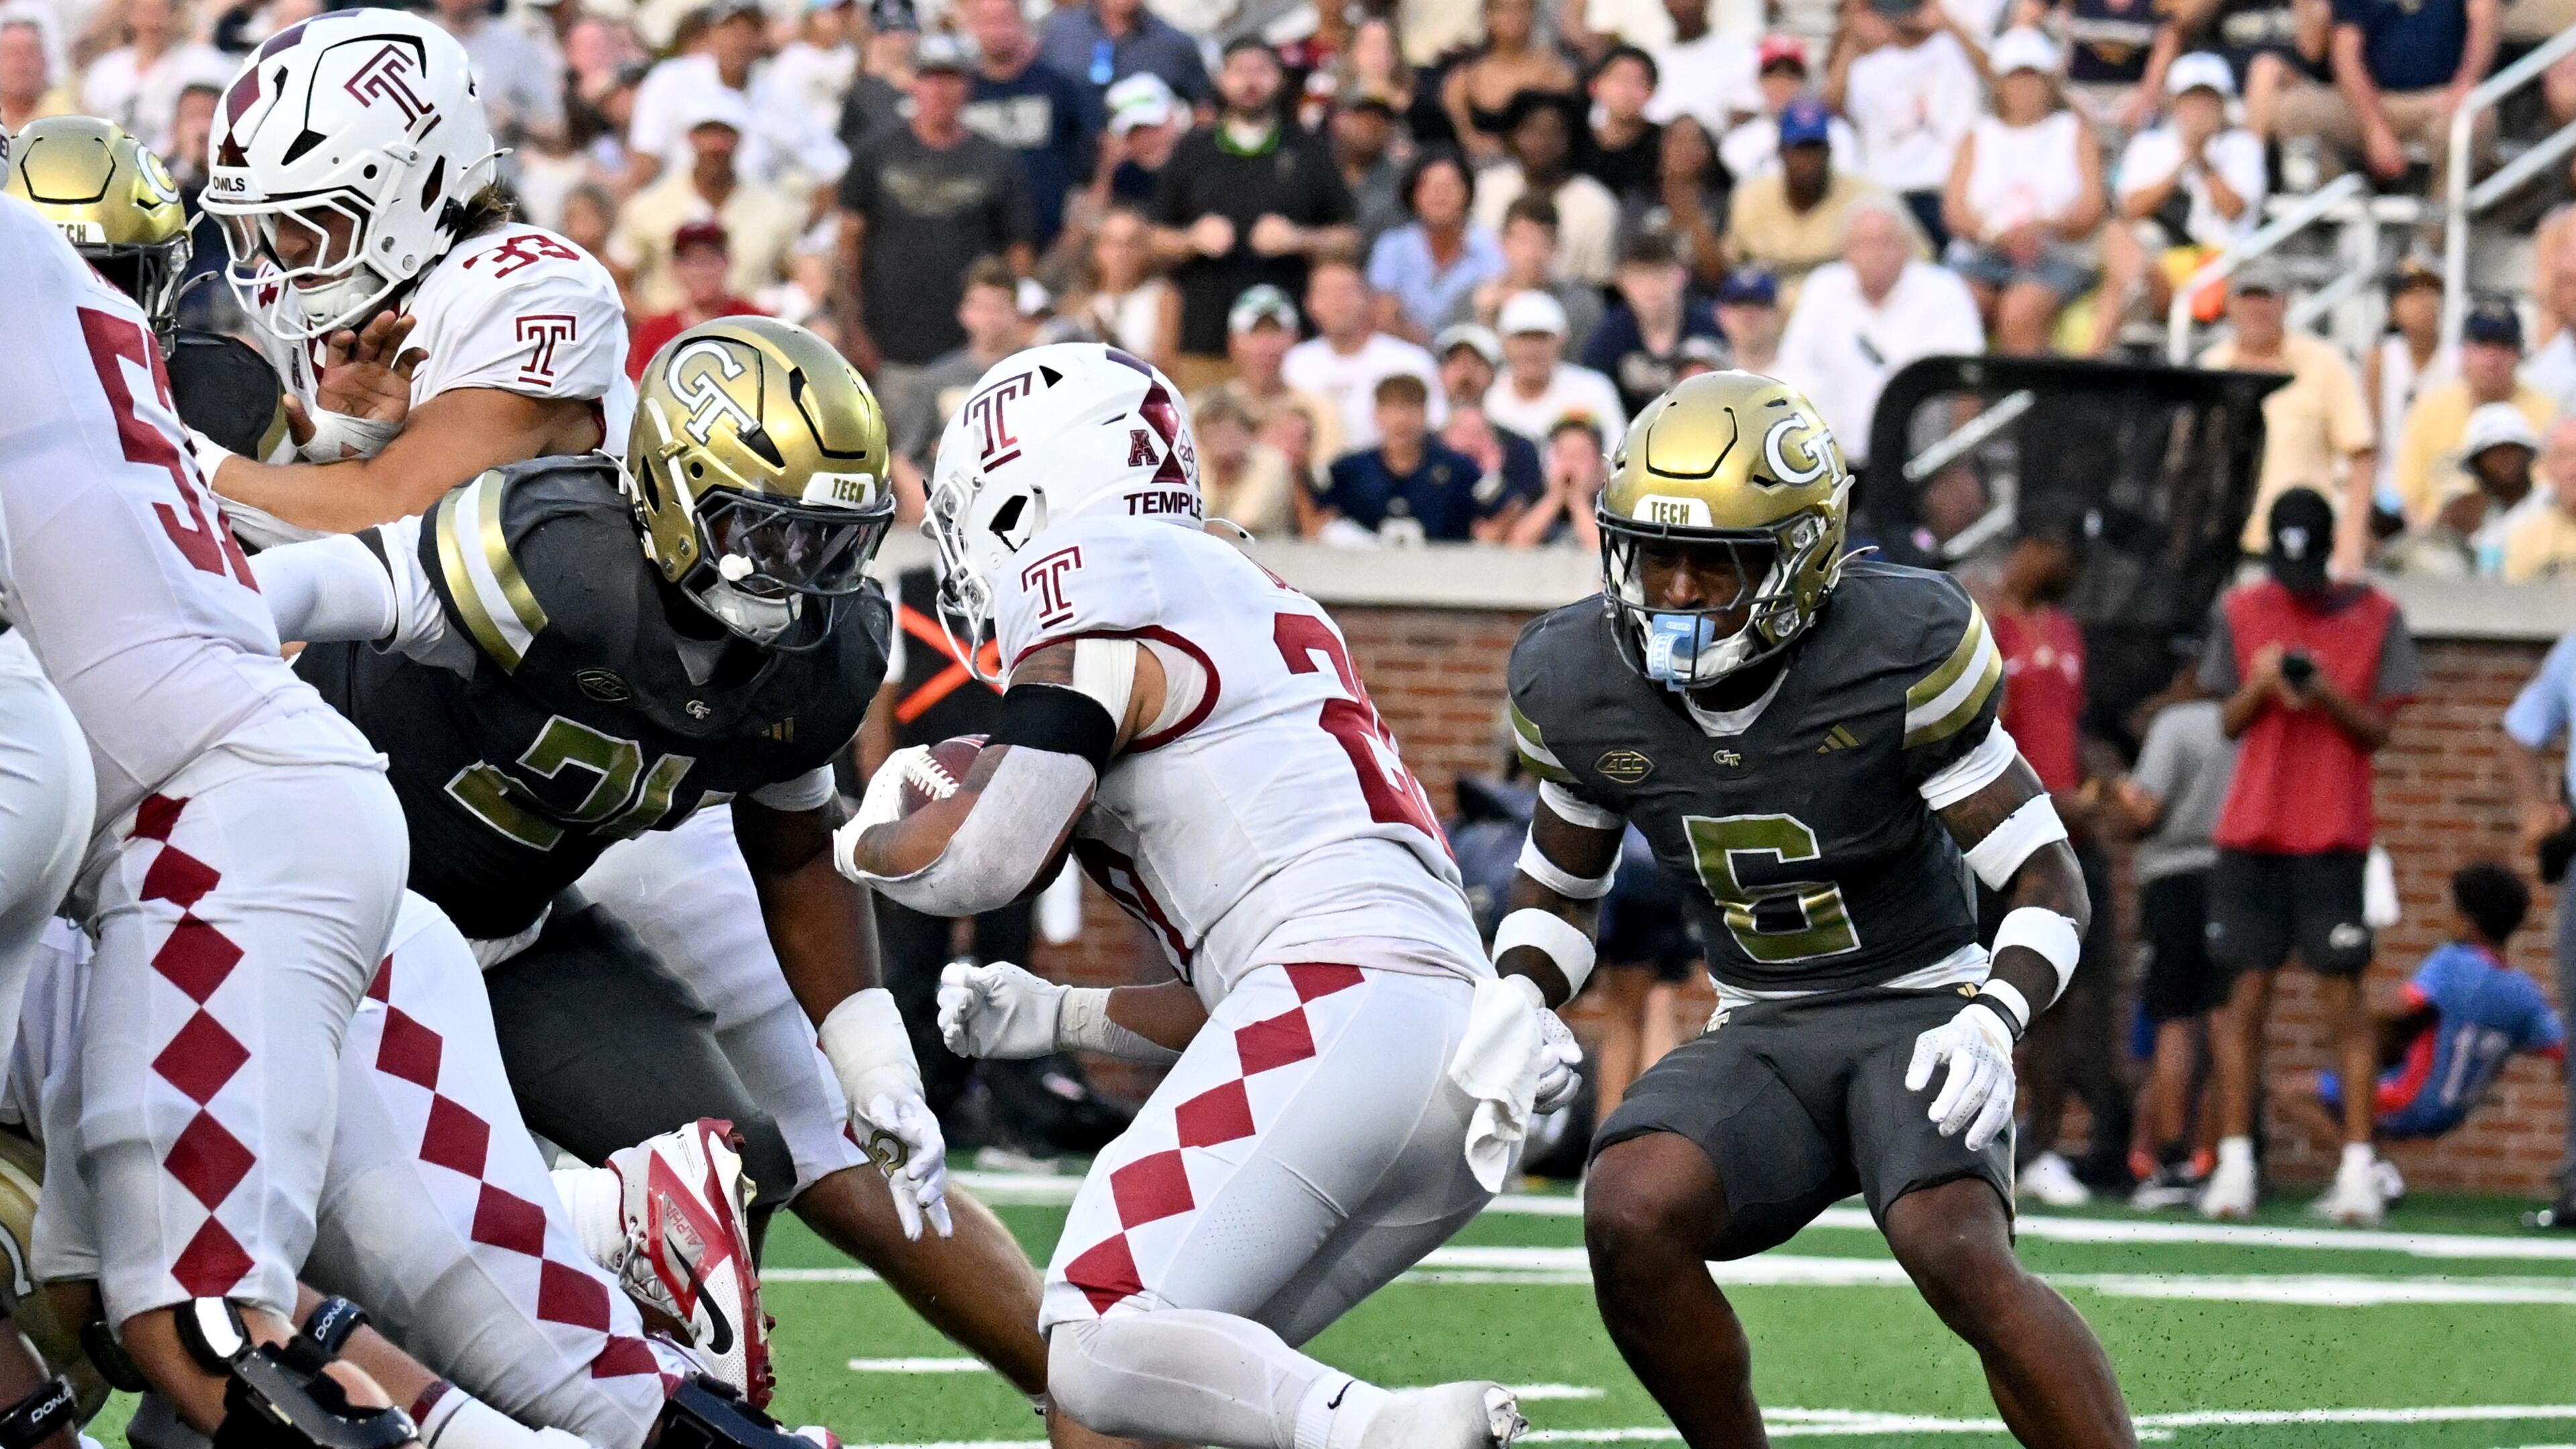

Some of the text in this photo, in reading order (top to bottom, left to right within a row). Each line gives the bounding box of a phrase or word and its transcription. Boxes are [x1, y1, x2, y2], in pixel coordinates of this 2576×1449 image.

[213, 176, 246, 192] OWLS
[463, 234, 580, 278] 33
[516, 314, 576, 387] T
[667, 339, 761, 447] GT
[1762, 412, 1843, 488] GT
[832, 478, 865, 504] TECH
[1123, 491, 1202, 522] TEMPLE
[1651, 501, 1690, 525] TECH
[1021, 545, 1082, 629] T
[685, 699, 712, 720] GT
[1605, 757, 1644, 771] ACC
[1713, 749, 1741, 767] GT
[1681, 812, 1862, 964] 6
[665, 1199, 705, 1249] ALPHA
